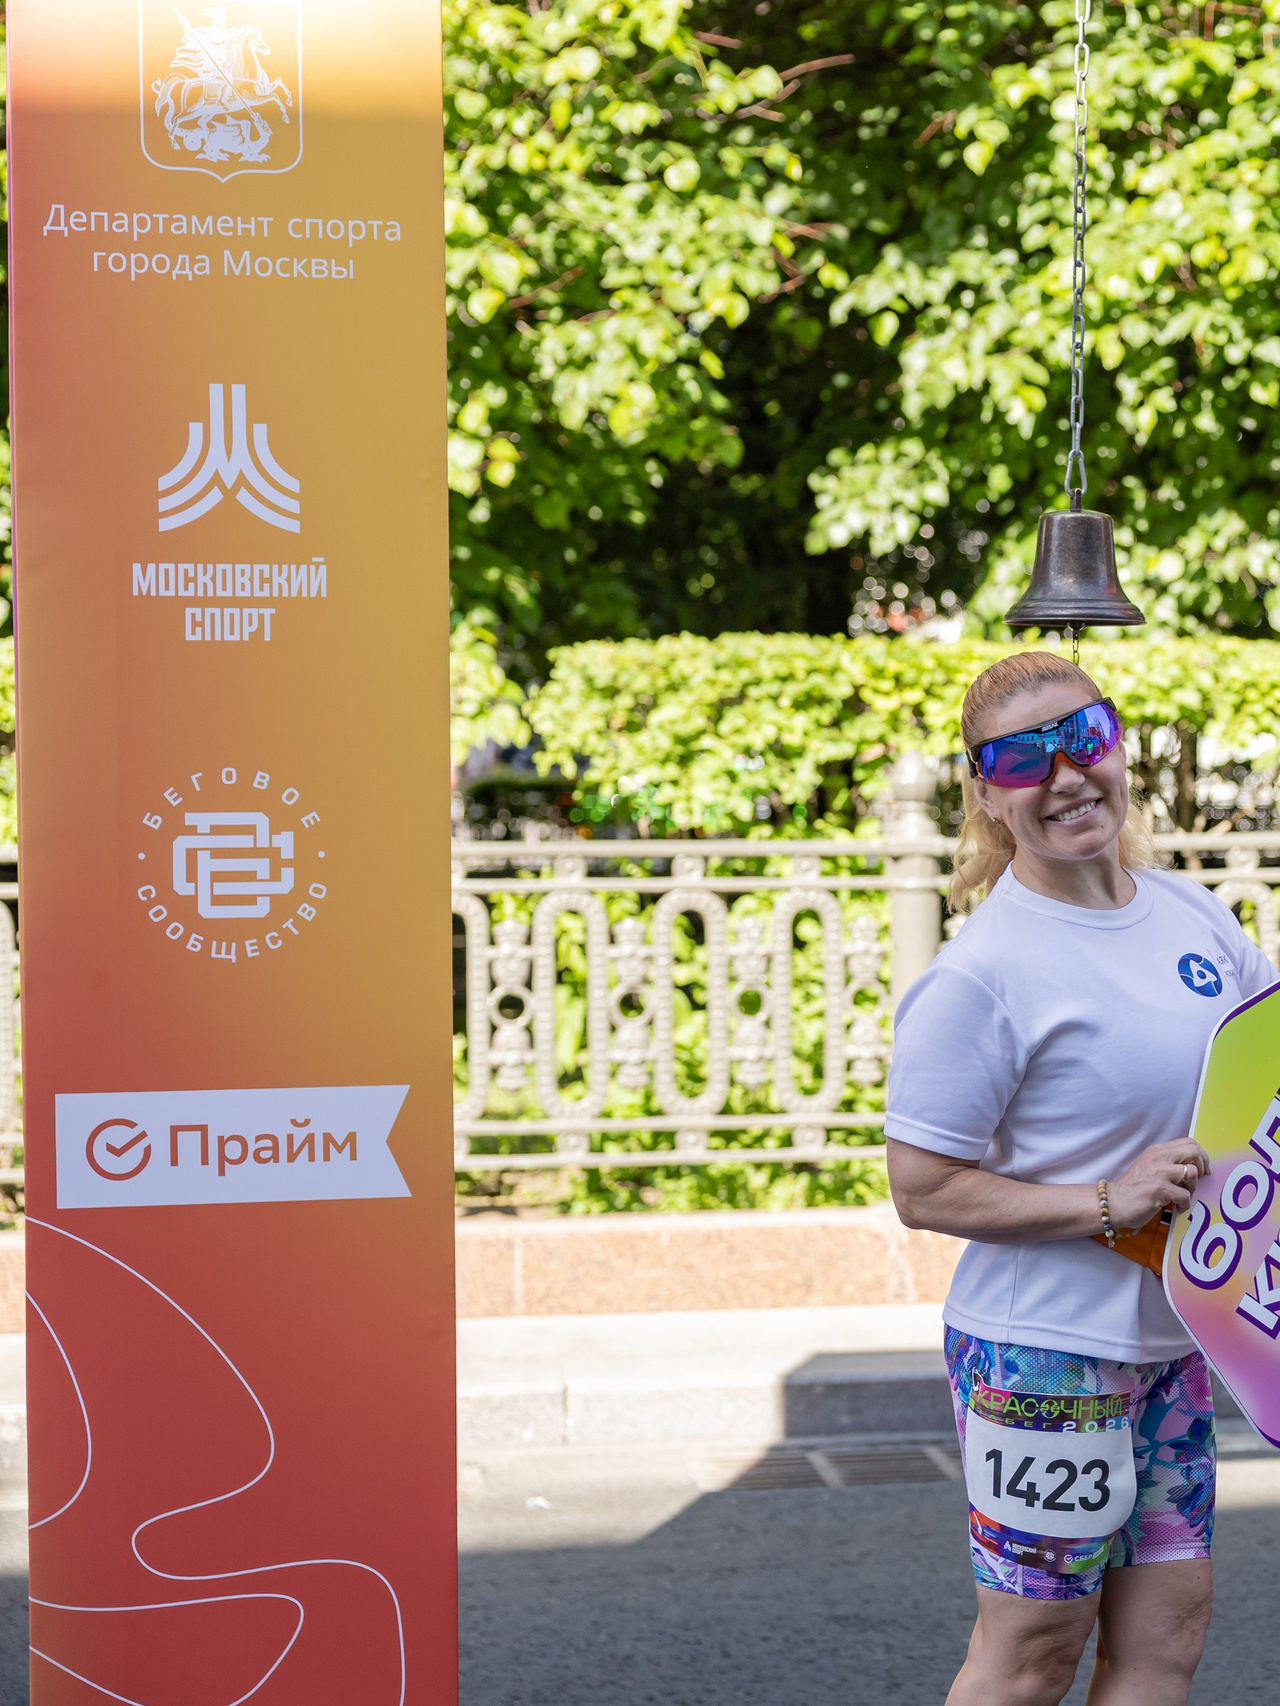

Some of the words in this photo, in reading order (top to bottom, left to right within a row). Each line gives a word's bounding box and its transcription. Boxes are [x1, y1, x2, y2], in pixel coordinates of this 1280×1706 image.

[43, 203, 273, 240] Департамент
[287, 216, 402, 248] спорта
[93, 248, 210, 281] города
[223, 249, 355, 279] Москвы
[132, 557, 327, 597] МОСКОВСКИЙ
[185, 607, 275, 641] СПОРТ
[142, 767, 321, 830] БЕГОВОЕ
[137, 882, 328, 962] СООБЩЕСТВО
[170, 1118, 358, 1177] Прайм
[1063, 1416, 1130, 1433] 2026
[985, 1448, 1110, 1512] 1423
